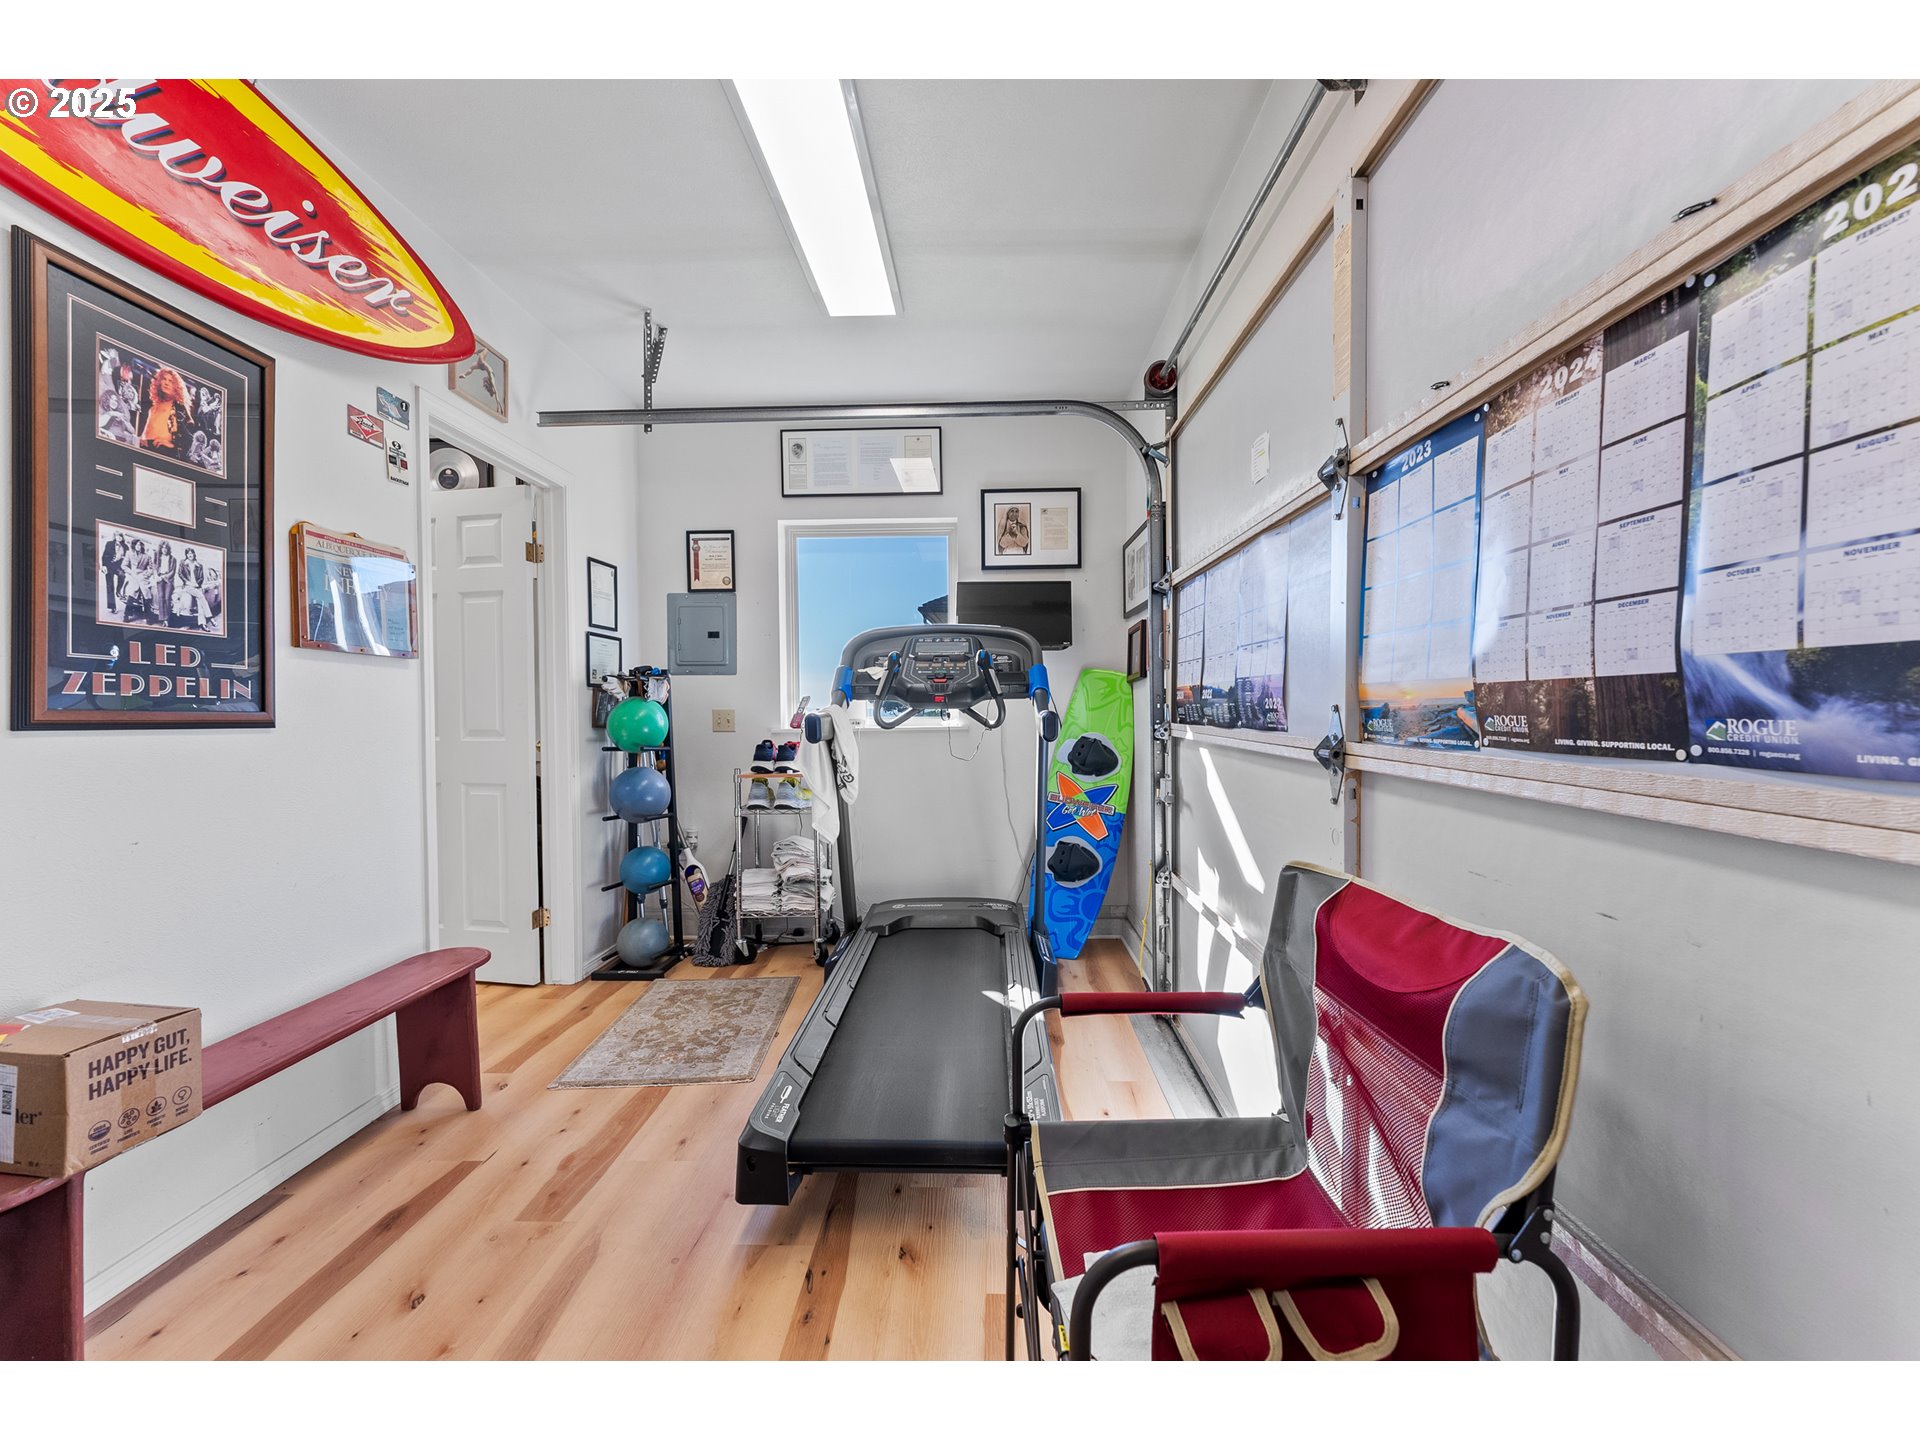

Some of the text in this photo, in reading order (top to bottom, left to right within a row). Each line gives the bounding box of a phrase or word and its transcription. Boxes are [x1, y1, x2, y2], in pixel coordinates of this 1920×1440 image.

[1856, 208, 1912, 242] FEBRUARY
[1868, 327, 1890, 341] MAY
[1633, 351, 1656, 367] MARCH
[1539, 346, 1601, 398] 2024
[1741, 381, 1763, 395] APRIL
[1554, 391, 1580, 408] FEBRUARY
[1632, 436, 1648, 447] JUNE
[1855, 432, 1896, 450] AUGUST
[1401, 439, 1432, 472] 2023
[1558, 467, 1569, 476] MAY
[1738, 475, 1755, 486] JULY
[1618, 514, 1656, 530] SEPTEMBER
[1551, 538, 1571, 549] AUGUST
[1843, 541, 1902, 558] NOVEMBER
[1726, 566, 1762, 579] OCTOBER
[1617, 598, 1650, 609] DECEMBER
[1545, 611, 1572, 621] NOVEMBER
[129, 640, 201, 668] LED
[61, 669, 253, 700] ZEPPELIN
[1493, 714, 1529, 728] ROGUE
[1726, 718, 1799, 737] ROGUE
[1554, 738, 1676, 751] LIVING. GIVING. SUPPORTING LOCAL.
[1726, 733, 1800, 745] CREDIT UNION
[1856, 755, 1904, 766] LIVING.
[88, 1028, 190, 1080] HAPPY GUT,
[88, 1047, 192, 1101] HAPPY LIFE.
